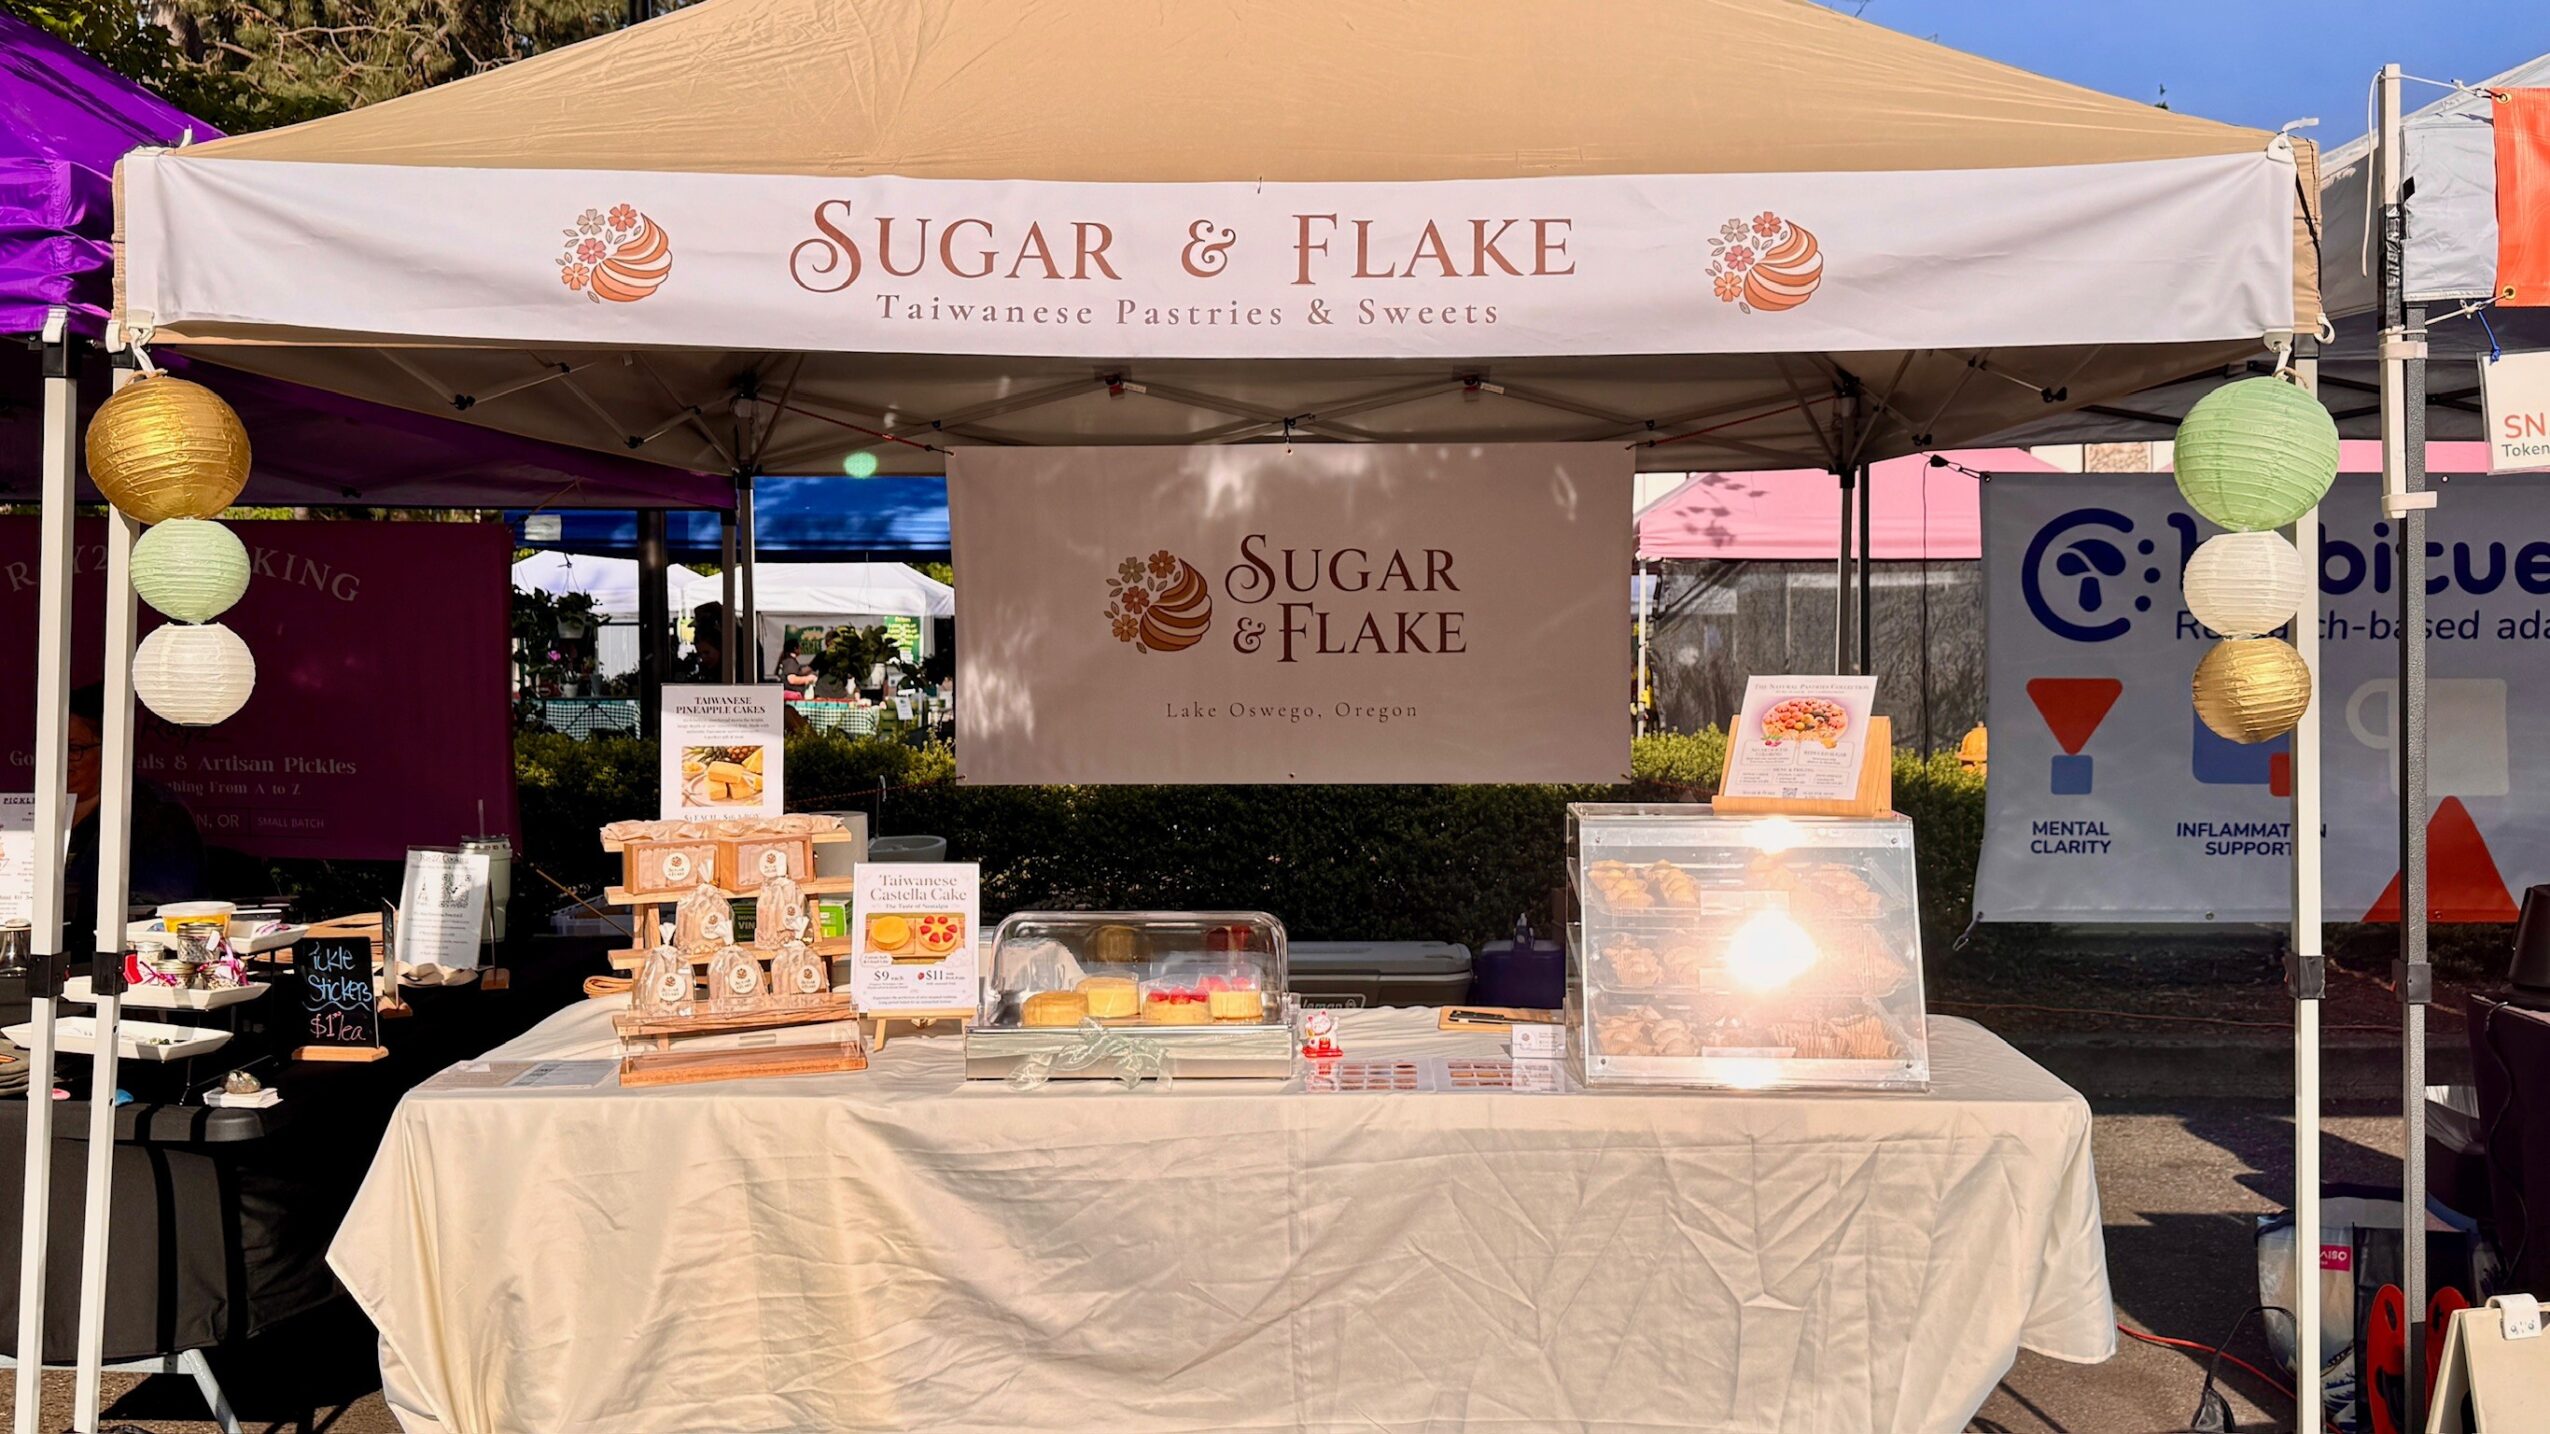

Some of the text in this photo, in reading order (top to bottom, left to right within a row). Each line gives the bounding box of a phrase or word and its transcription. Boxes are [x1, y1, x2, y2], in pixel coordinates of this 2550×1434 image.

[1180, 219, 1237, 277] &
[876, 293, 1499, 327] Taiwanese Pastries & Sweets
[2503, 411, 2550, 440] SN
[2167, 511, 2550, 596] bitue
[1233, 617, 1267, 654] &
[694, 696, 752, 705] TAIWANESE
[675, 705, 766, 714] PINEAPPLE CAKES
[1166, 700, 1418, 724] Lake Oswego, Oregon
[199, 753, 275, 772] Artisan
[284, 755, 357, 774] Pickles
[209, 783, 248, 794] From
[272, 783, 286, 796] to
[3, 797, 35, 805] PICKL
[217, 814, 240, 829] OR
[2032, 820, 2110, 837] MENTAL
[2030, 839, 2112, 855] CLARITY
[879, 875, 958, 887] Taiwanese
[870, 888, 968, 901] Castella Cake
[738, 921, 756, 930] VIN
[874, 970, 890, 982] $9
[925, 970, 944, 981] $11
[307, 974, 373, 1003] Stickers
[2319, 1250, 2347, 1261] AISO
